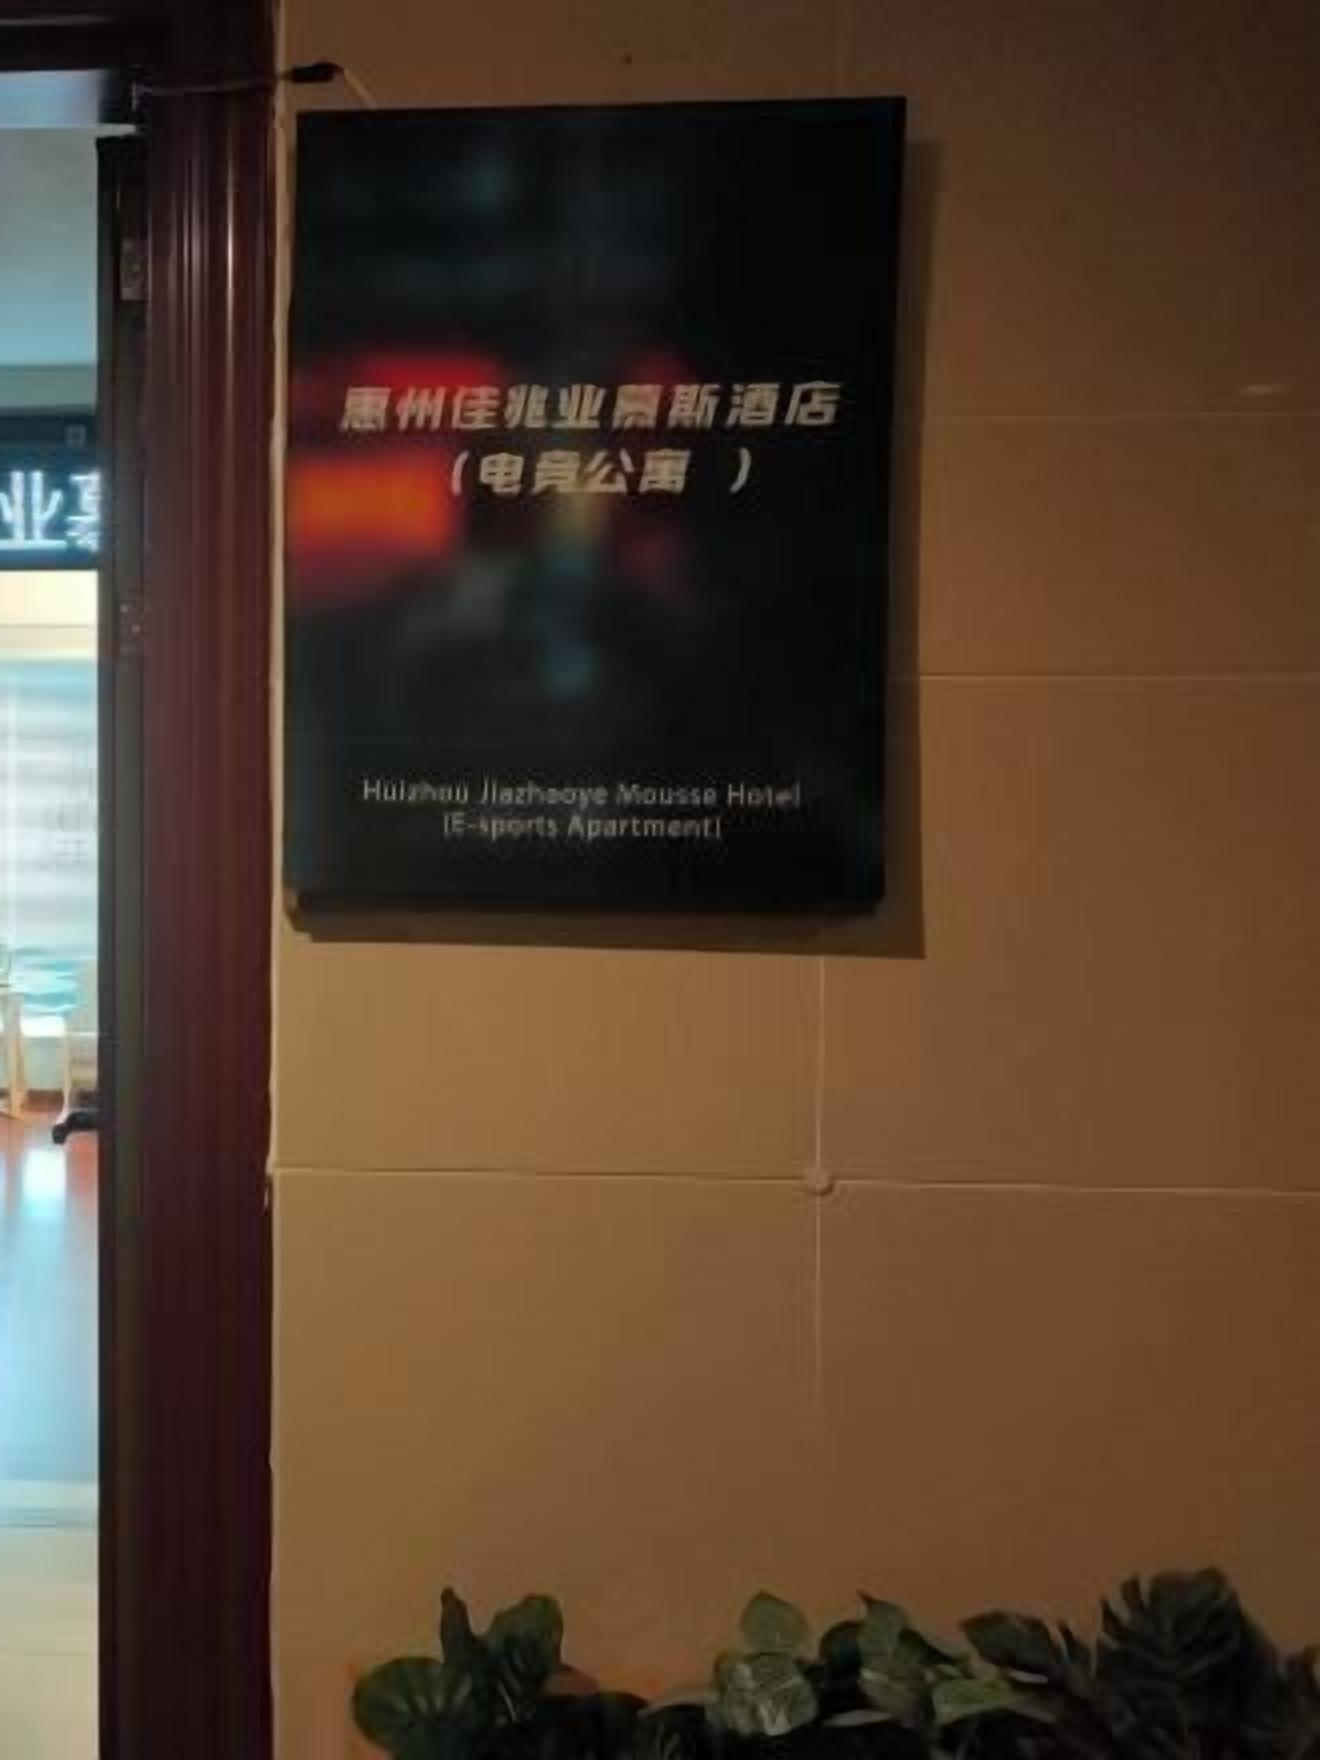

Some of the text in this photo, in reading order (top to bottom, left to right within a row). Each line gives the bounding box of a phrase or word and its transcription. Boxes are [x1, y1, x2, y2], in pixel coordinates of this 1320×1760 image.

[340, 381, 843, 432] 惠州佳兆业慕斯酒店
[726, 782, 801, 808] Hotel
